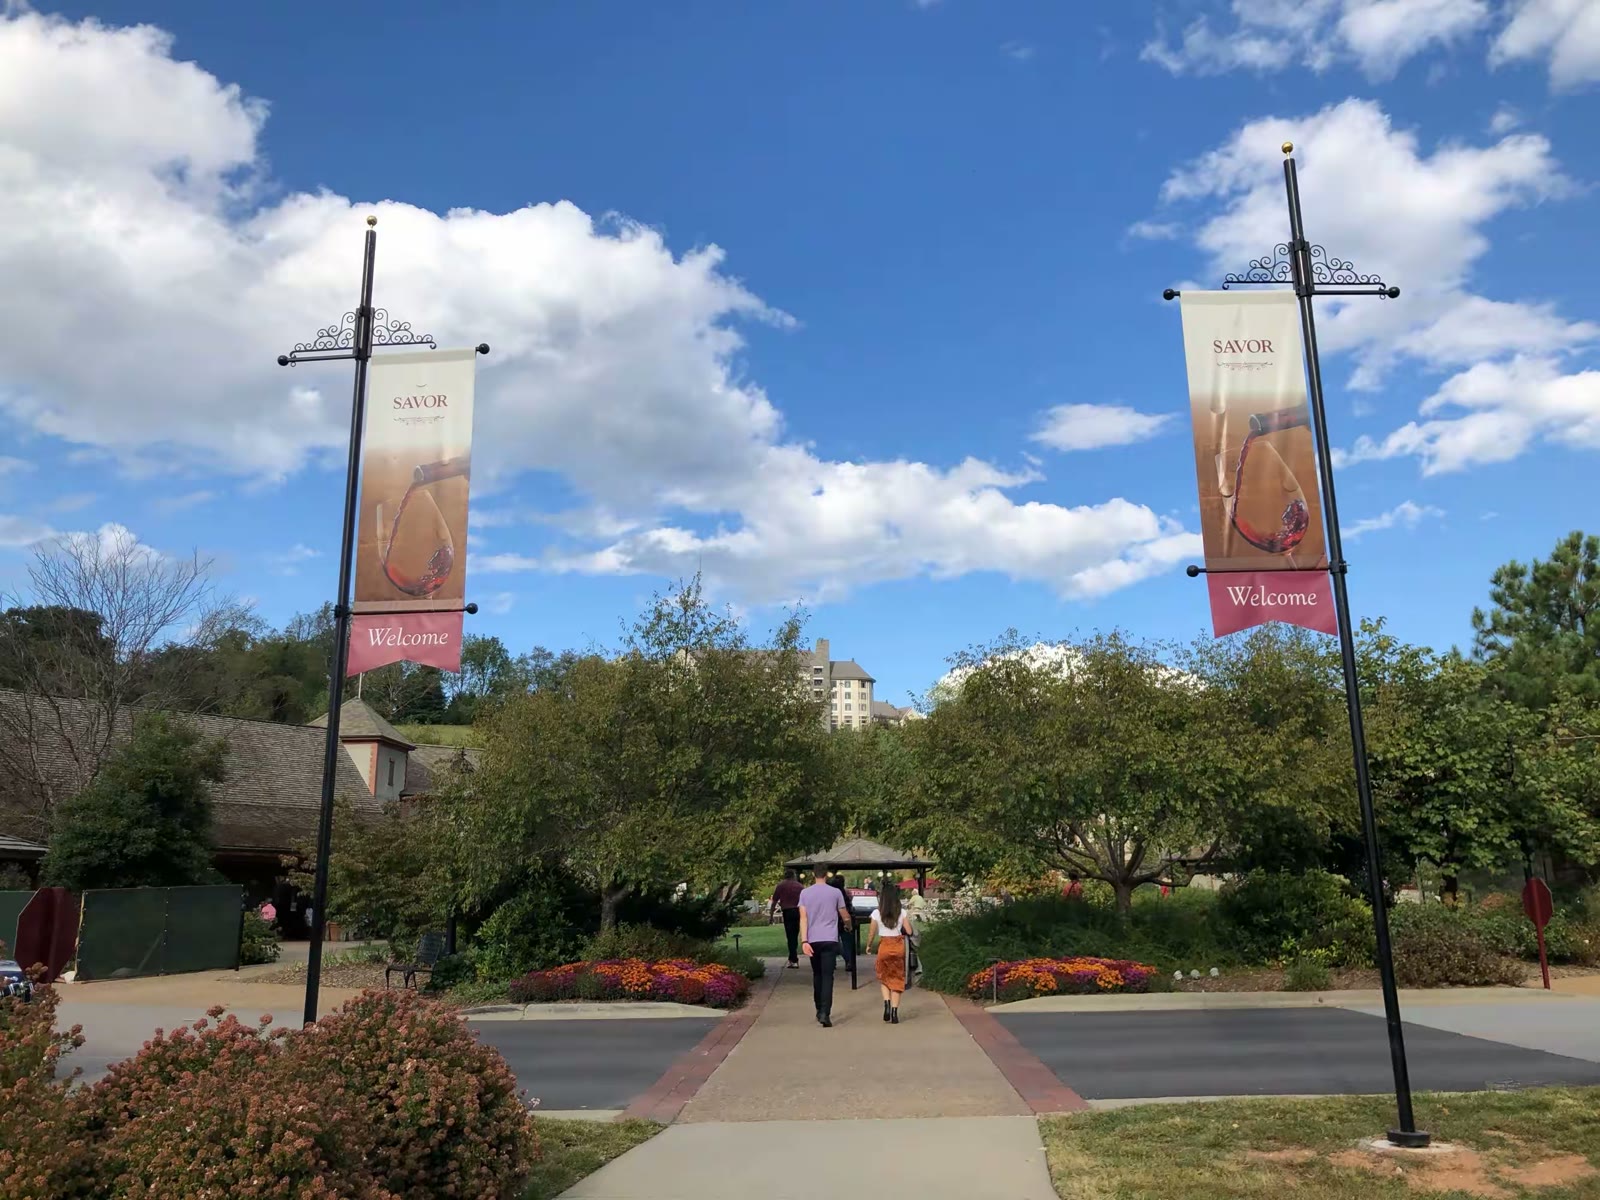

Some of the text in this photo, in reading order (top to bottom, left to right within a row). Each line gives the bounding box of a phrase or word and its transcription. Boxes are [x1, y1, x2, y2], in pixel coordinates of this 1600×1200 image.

[1213, 339, 1275, 354] SAVOR
[393, 394, 448, 410] SAVOR
[1226, 585, 1318, 606] Welcome
[367, 627, 449, 647] Welcome
